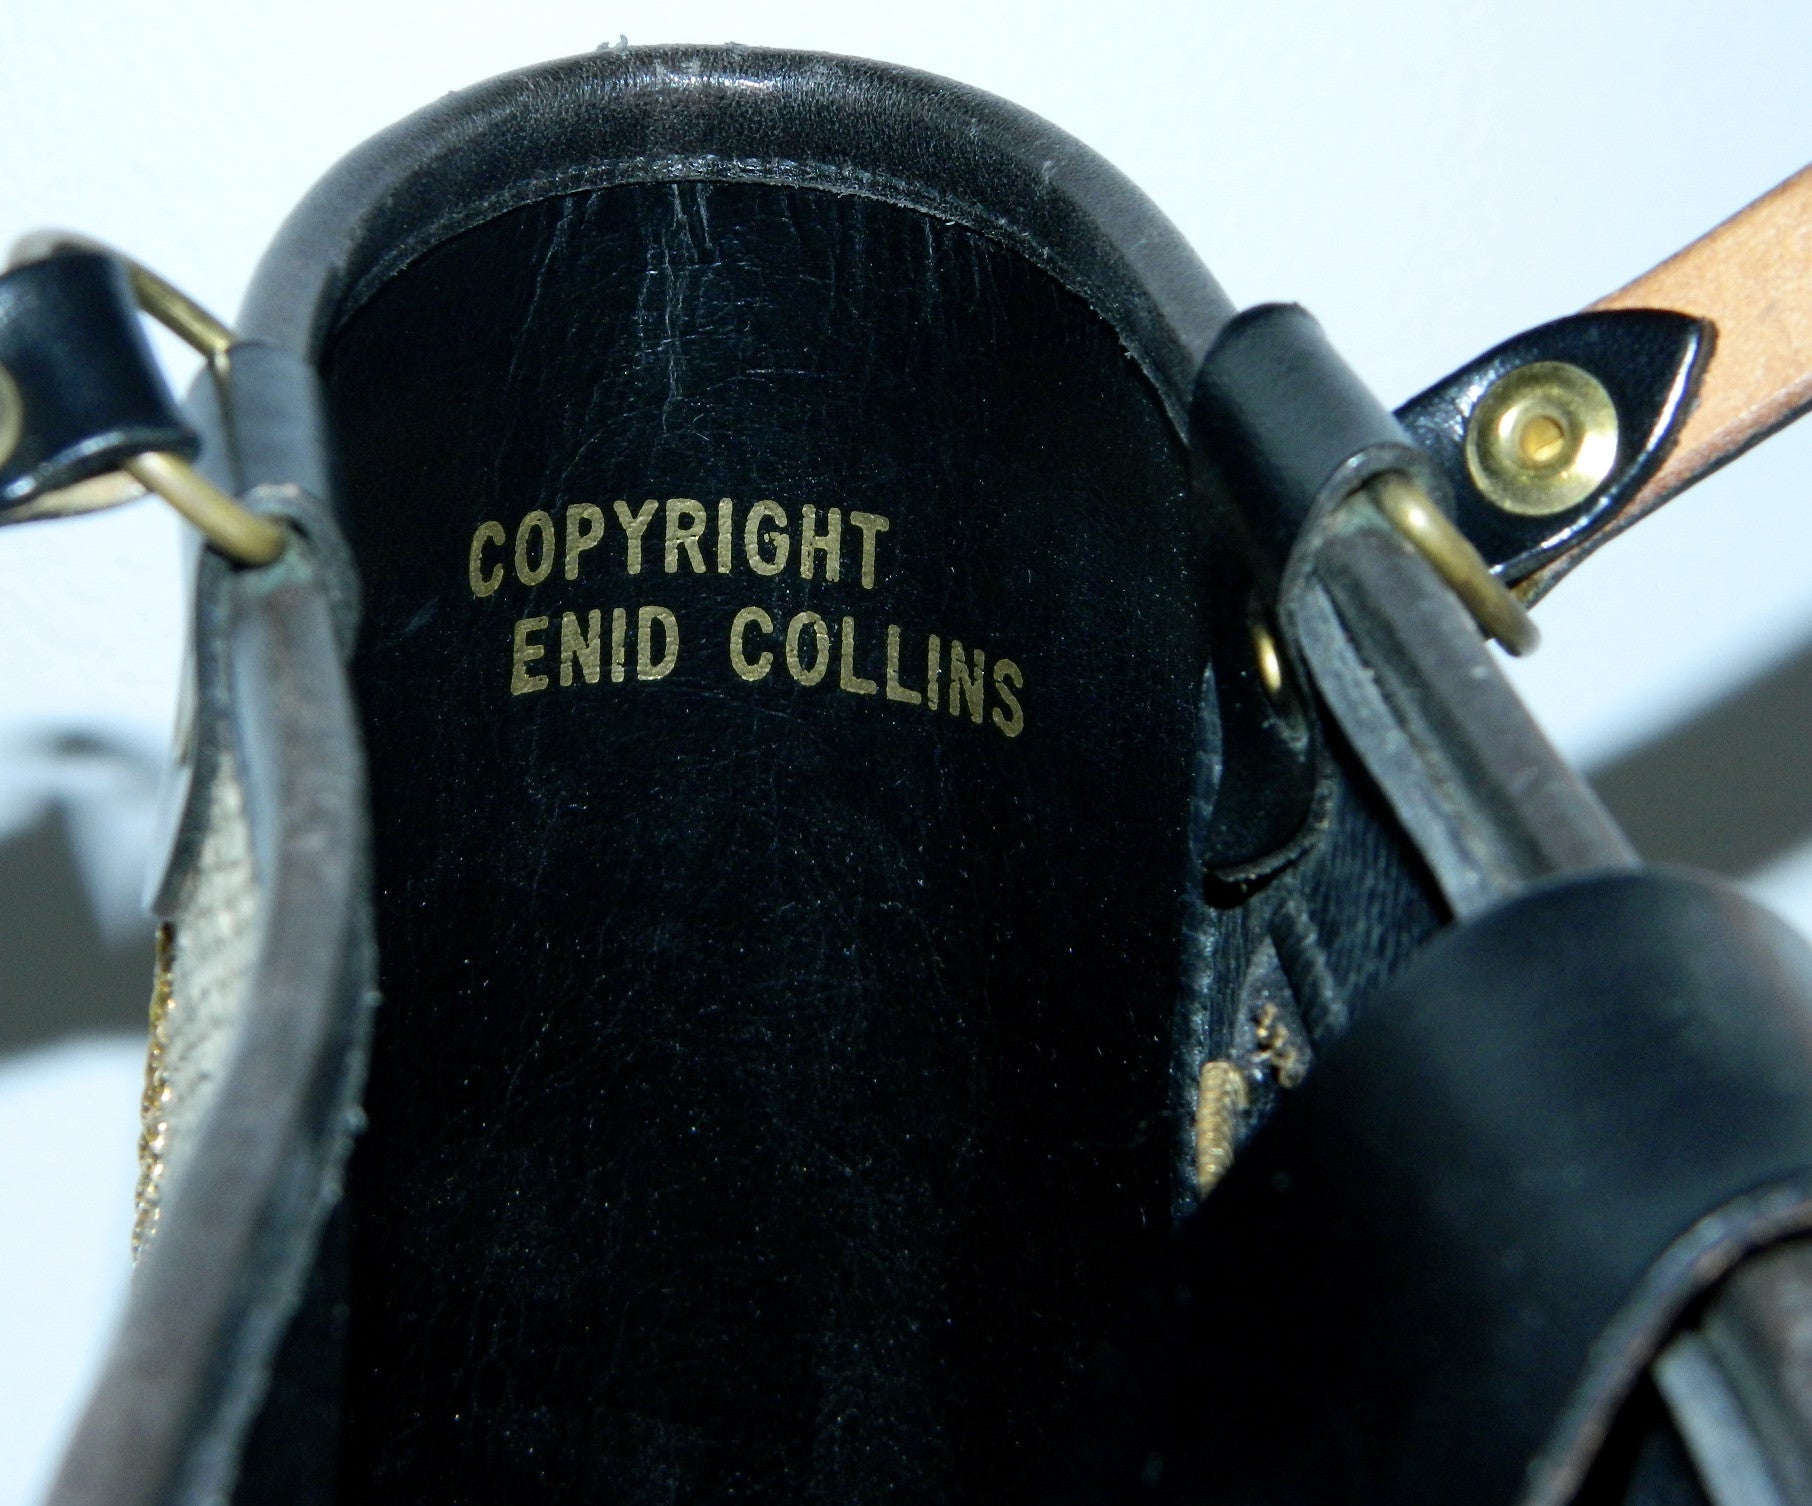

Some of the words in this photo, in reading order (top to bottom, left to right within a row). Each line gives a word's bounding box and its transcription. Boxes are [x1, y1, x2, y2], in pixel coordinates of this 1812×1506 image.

[469, 498, 890, 598] COPYRIGHT
[510, 605, 679, 695] ENID
[729, 606, 1024, 738] COLLINS
